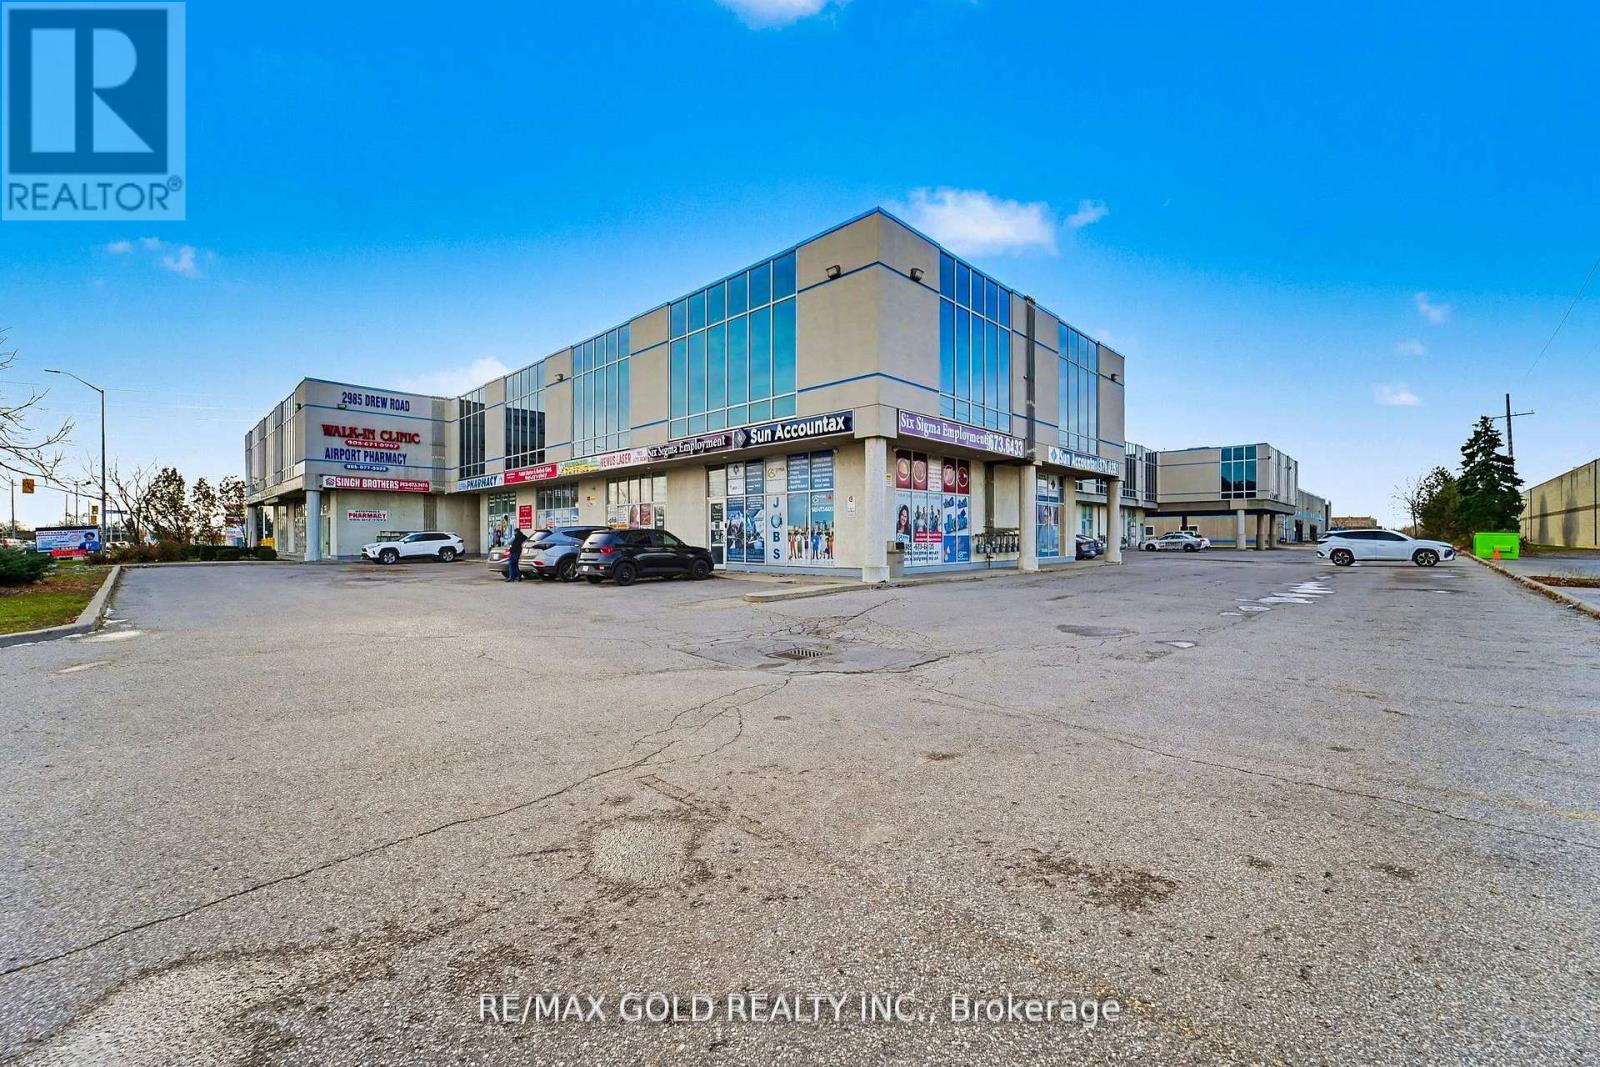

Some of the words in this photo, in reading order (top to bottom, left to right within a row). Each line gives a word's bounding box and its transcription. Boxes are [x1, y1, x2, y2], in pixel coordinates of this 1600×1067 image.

[342, 391, 362, 405] 2985
[365, 394, 388, 409] DREW
[390, 398, 410, 411] ROAD
[321, 424, 375, 440] WALK-IN
[380, 430, 420, 444] CLINIC
[751, 428, 771, 444] Sun
[775, 416, 845, 440] Accountax
[901, 413, 914, 429] Six
[916, 416, 940, 437] Sigma
[942, 423, 988, 444] Employment
[325, 447, 361, 462] AIRPORT
[363, 450, 407, 464] PHARMACY
[648, 446, 657, 457] Six
[658, 445, 677, 458] Sigma
[679, 435, 726, 454] Employment
[617, 453, 632, 465] LASER
[335, 477, 359, 488] SINGH
[362, 478, 399, 490] BROTHERS
[466, 475, 498, 489] PHARMACY
